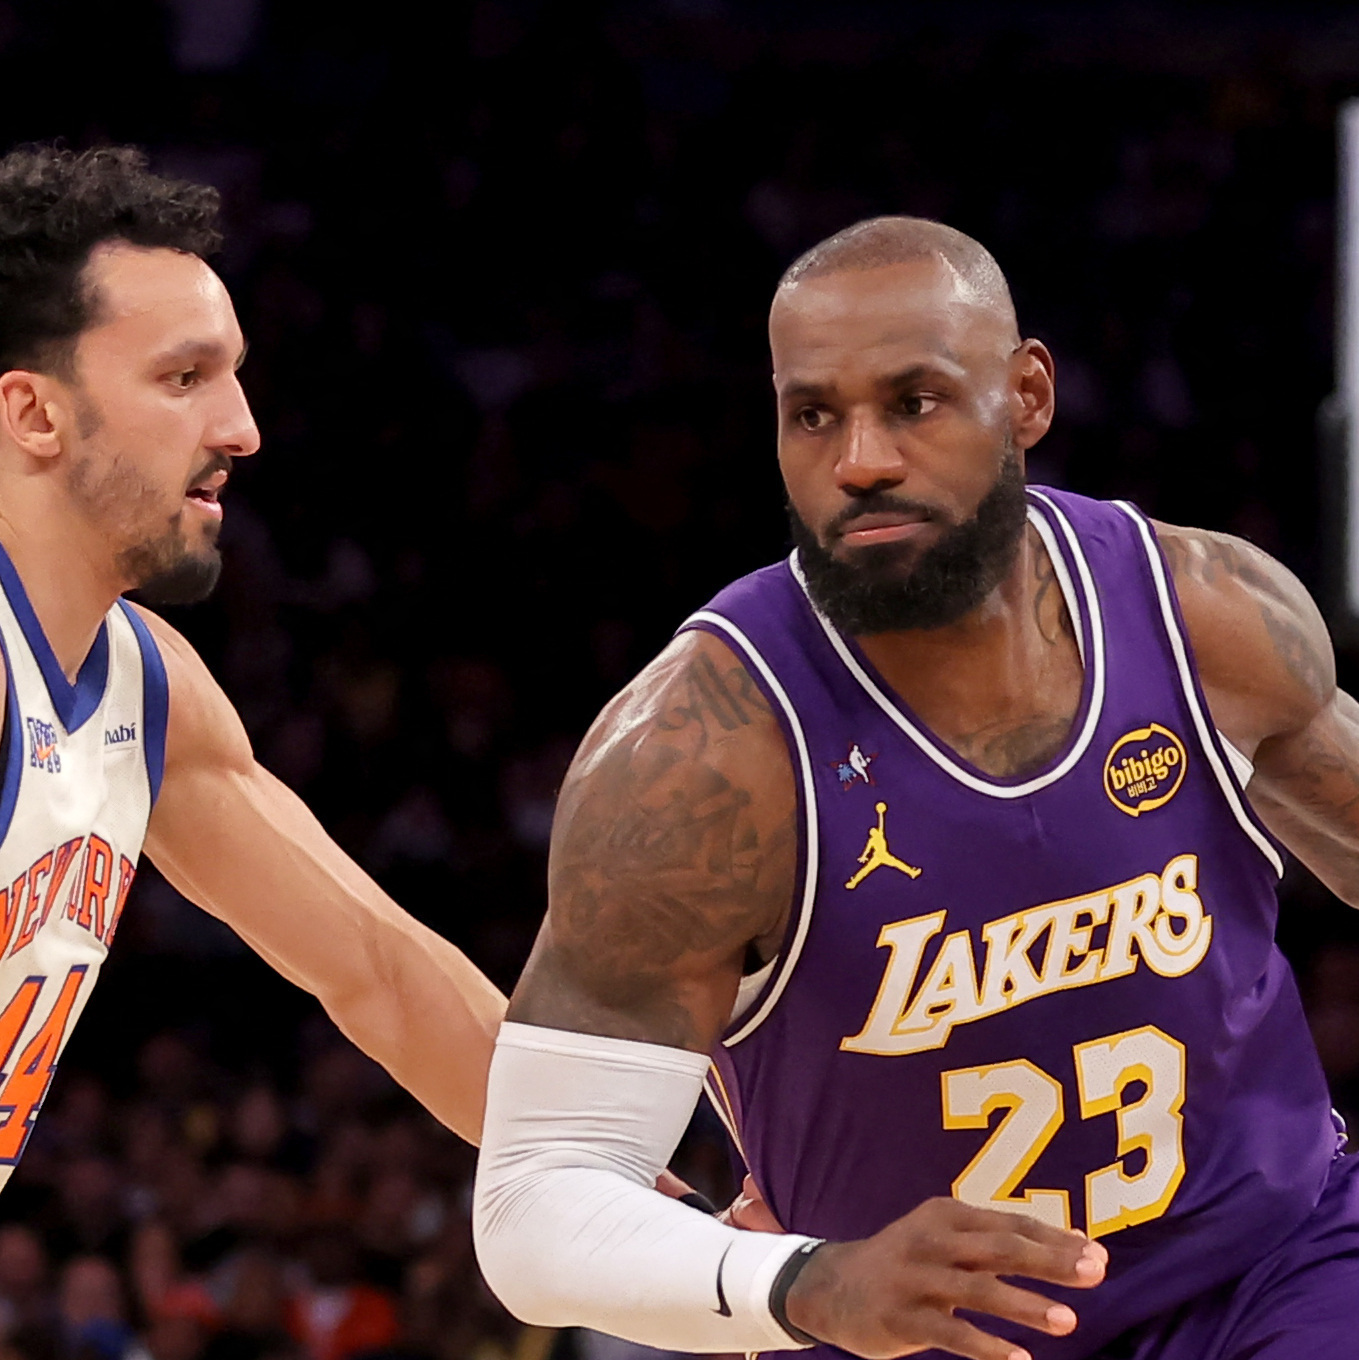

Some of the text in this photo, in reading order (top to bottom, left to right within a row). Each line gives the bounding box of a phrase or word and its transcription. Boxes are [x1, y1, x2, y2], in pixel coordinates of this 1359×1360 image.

[1109, 747, 1179, 790] bibigo
[1127, 777, 1157, 798] 비비고
[839, 854, 1213, 1056] LAKERS
[941, 1024, 1186, 1241] 23
